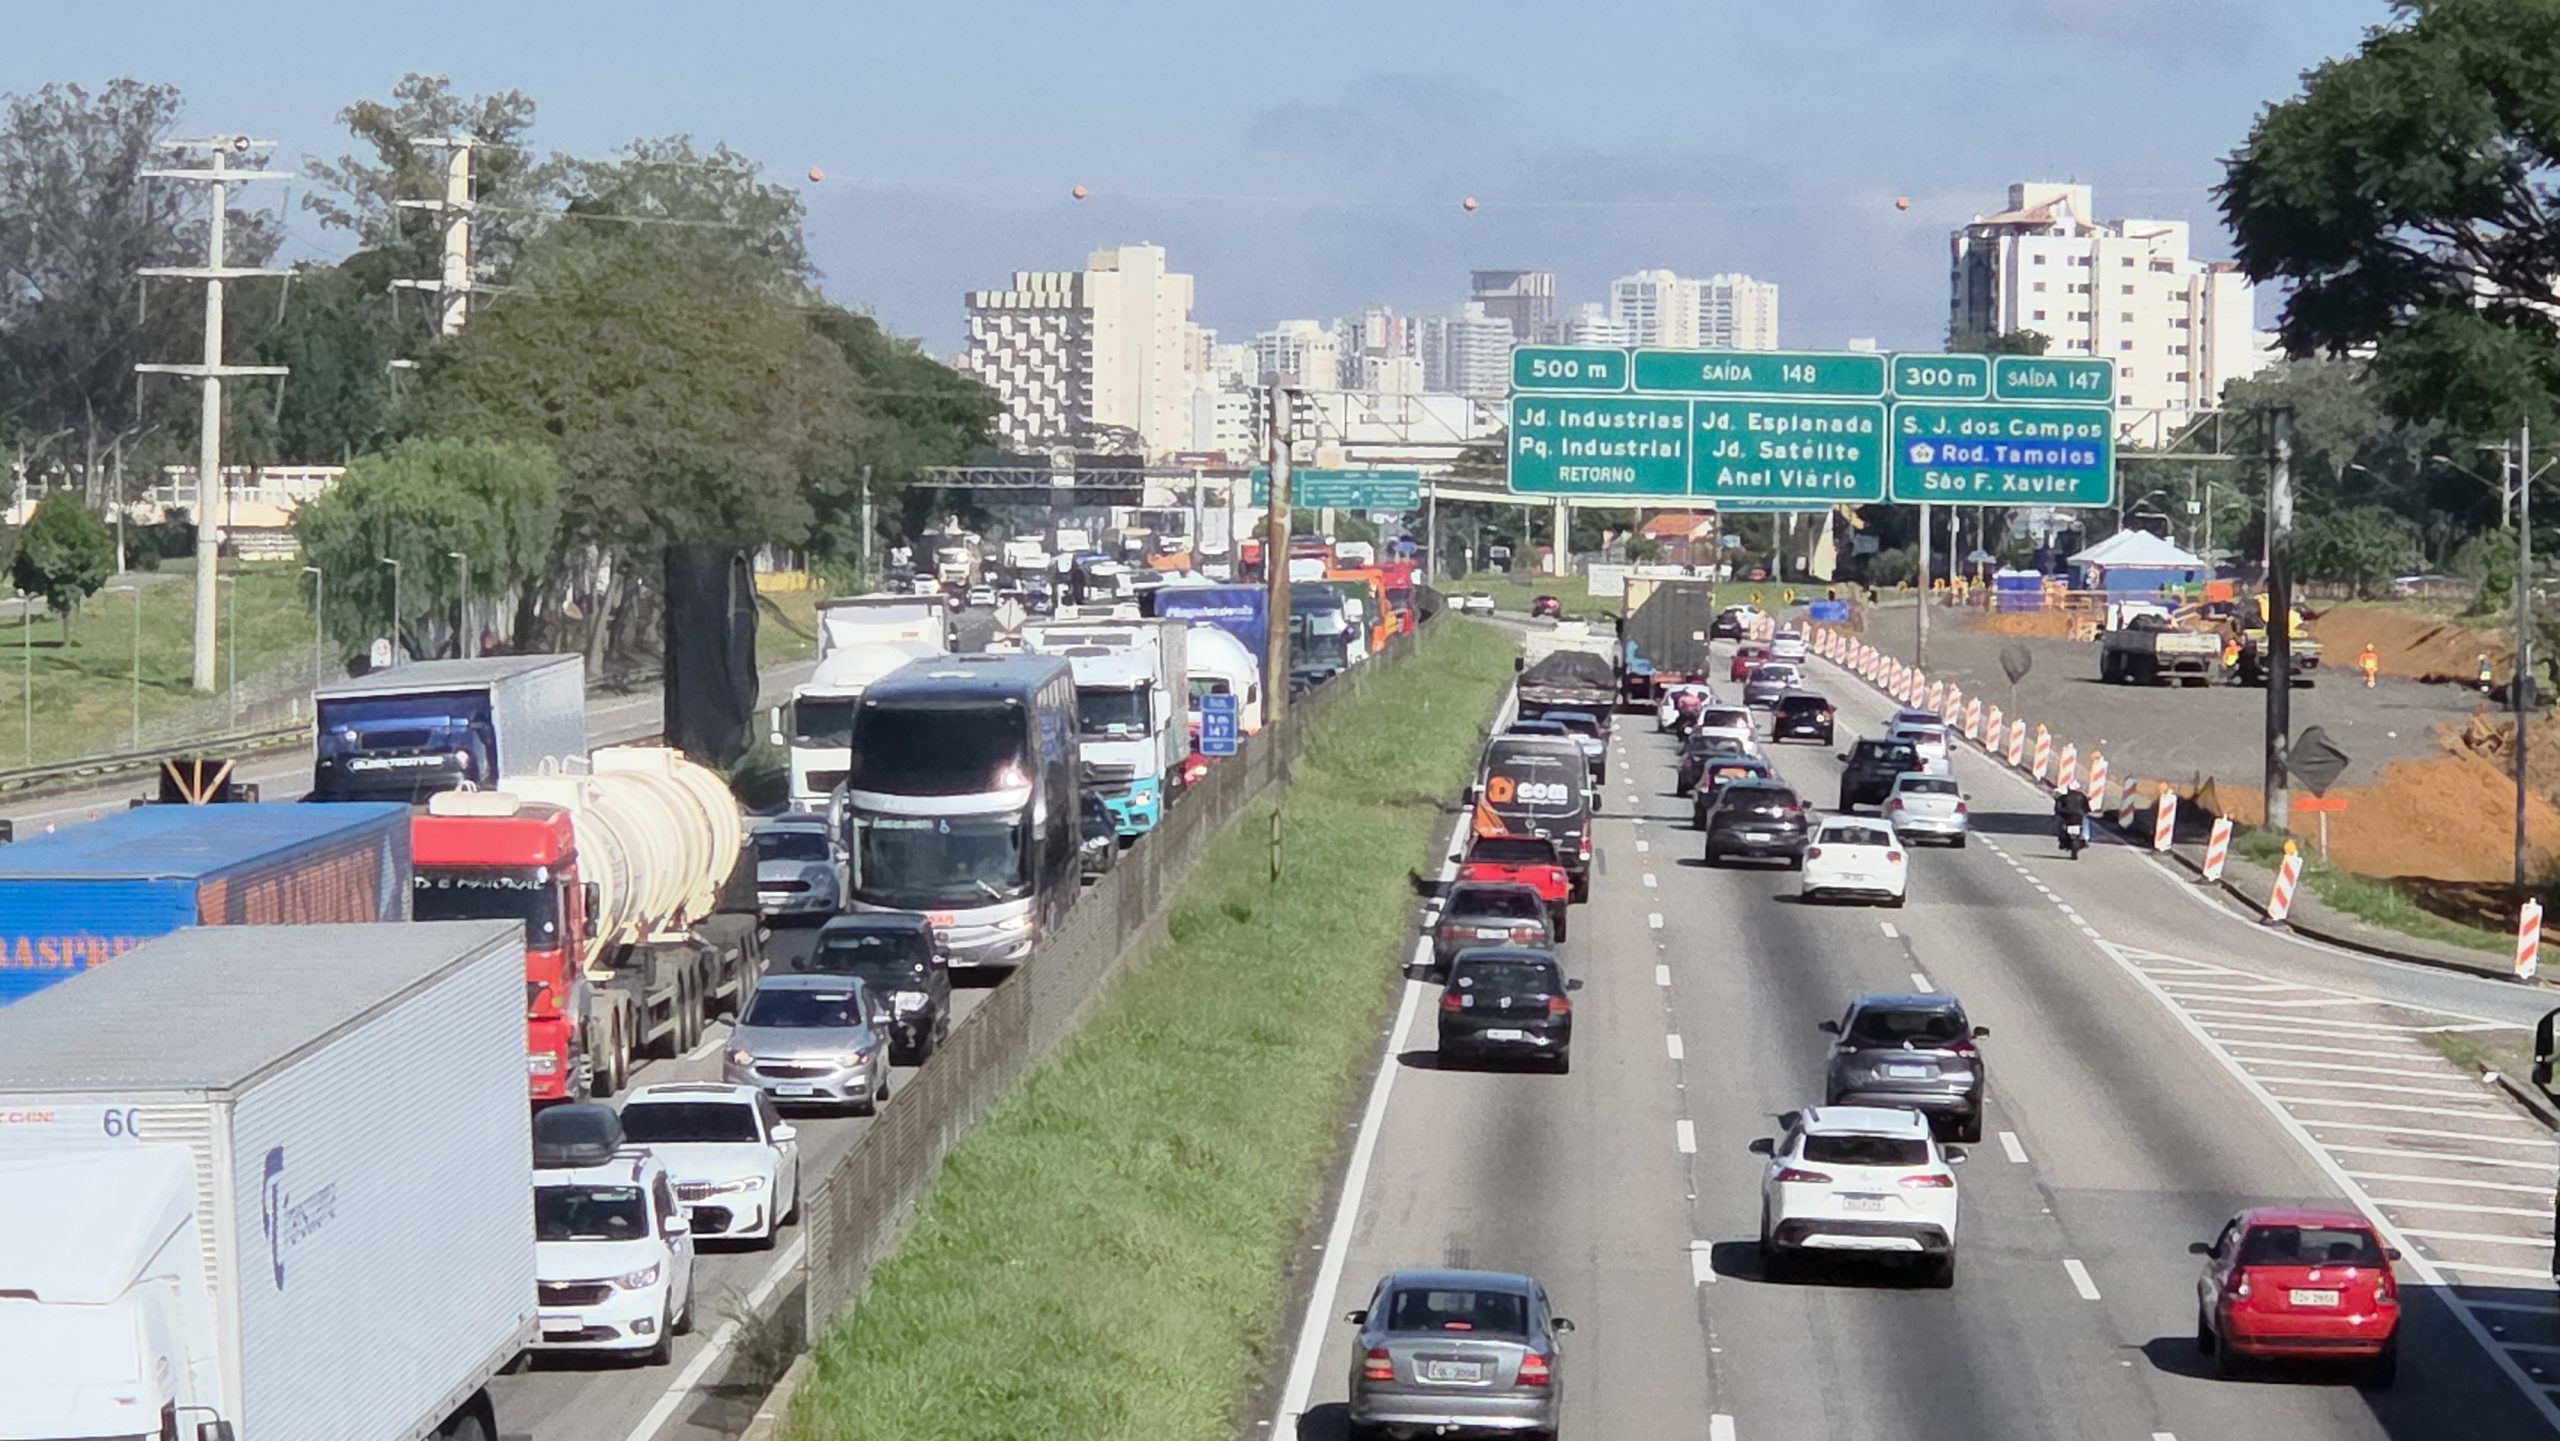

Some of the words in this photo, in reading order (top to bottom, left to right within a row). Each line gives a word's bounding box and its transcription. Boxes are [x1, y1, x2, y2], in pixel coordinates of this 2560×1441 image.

[1532, 359, 1579, 378] 500
[1588, 364, 1607, 378] m
[1702, 360, 1752, 381] SAÍDA
[1782, 364, 1816, 383] 148
[1906, 368, 1953, 386] 300
[1958, 373, 1977, 387] m
[2007, 367, 2058, 388] SAÍDA
[2069, 371, 2101, 390] 147
[1519, 408, 1552, 427] Jd.
[1702, 411, 1735, 431] Jd.
[1748, 412, 1873, 435] Esplanada
[1903, 415, 1923, 434] S.
[1932, 416, 1952, 435] J.
[1960, 418, 2000, 436] dos
[2009, 419, 2102, 441] Campos
[1519, 437, 1552, 459] Pq.
[1562, 438, 1681, 458] Industrial
[1712, 439, 1746, 459] Jd.
[1759, 438, 1860, 462] Satélite
[1942, 444, 1989, 463] Rod.
[1994, 445, 2096, 465] Tamoios
[1559, 467, 1636, 483] RETORNO
[1717, 467, 1771, 486] Anel
[1780, 468, 1856, 489] Viário
[1924, 472, 1966, 490] São
[1974, 473, 1993, 491] F.
[2002, 474, 2080, 492] Xavier
[1209, 725, 1229, 736] 147
